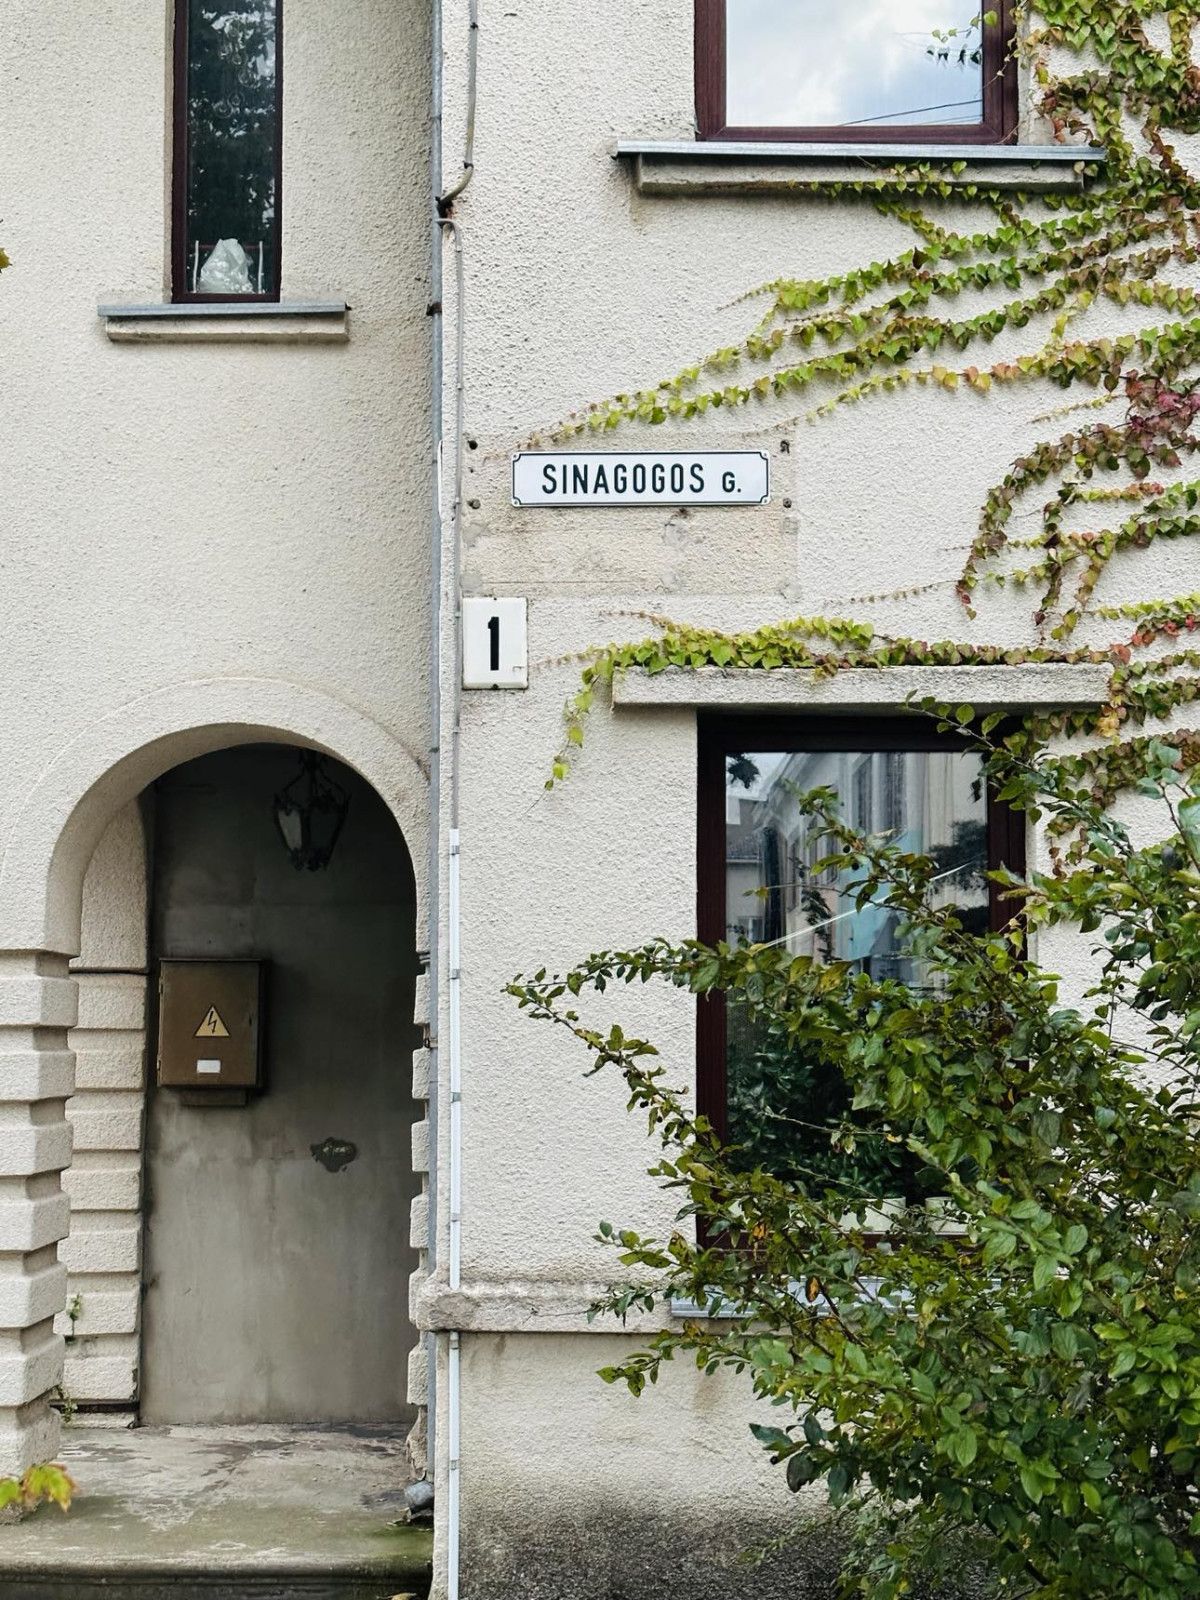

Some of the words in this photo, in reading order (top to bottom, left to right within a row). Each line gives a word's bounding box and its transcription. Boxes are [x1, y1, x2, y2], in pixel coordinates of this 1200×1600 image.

[541, 463, 705, 495] SINAGOGOS
[722, 471, 742, 494] G.
[487, 616, 500, 671] 1
